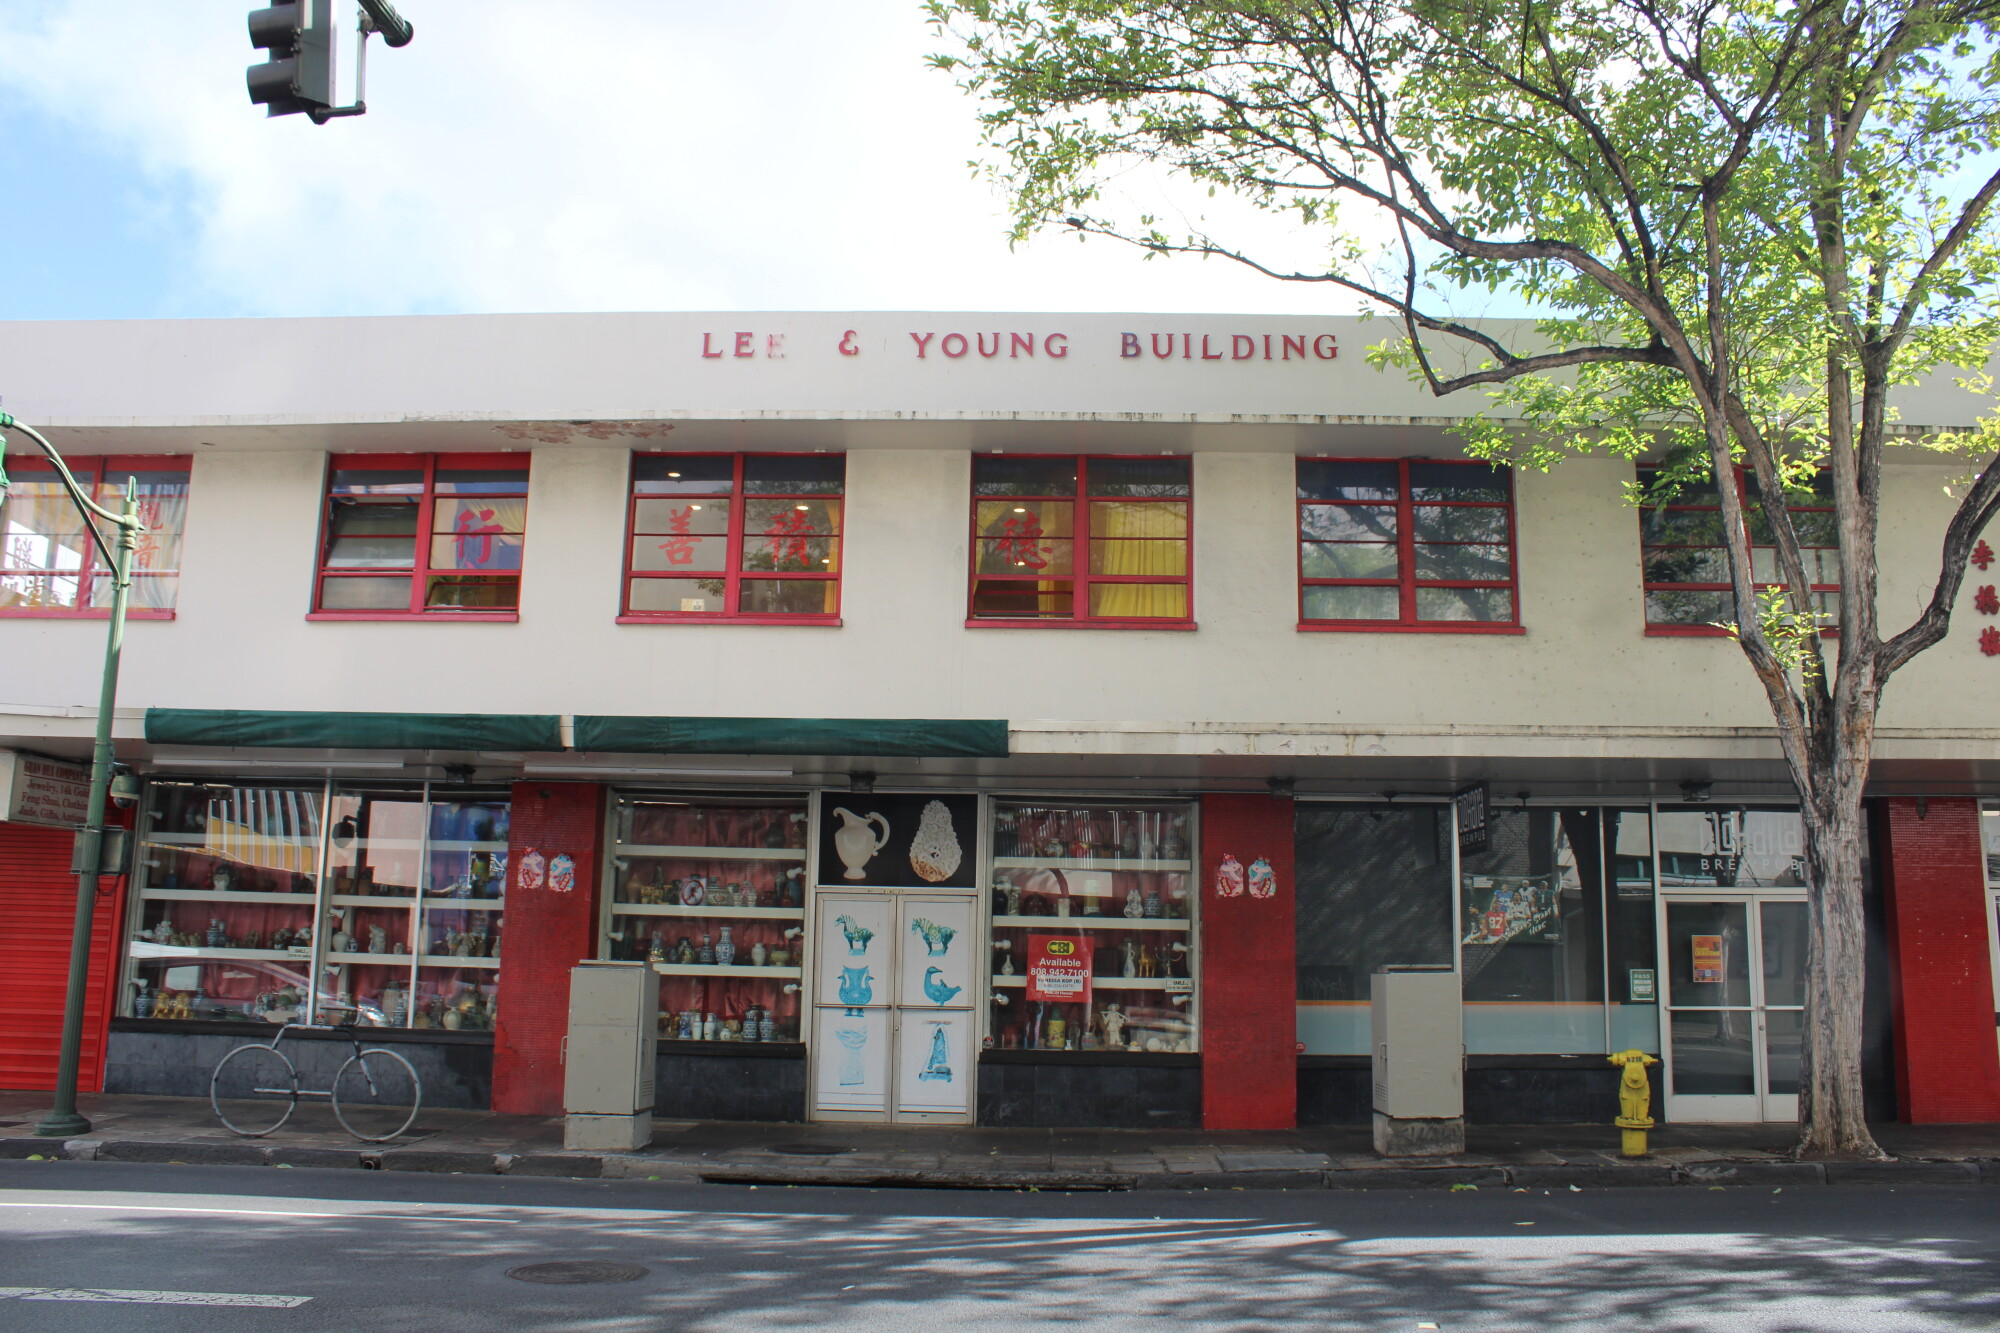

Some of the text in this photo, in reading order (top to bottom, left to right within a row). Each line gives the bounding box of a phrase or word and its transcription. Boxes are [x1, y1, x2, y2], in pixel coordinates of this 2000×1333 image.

[701, 329, 1339, 361] LEE & YOUNG BUILDING
[451, 508, 505, 565] 行
[657, 504, 704, 566] 善
[27, 778, 58, 794] Jewelry,
[21, 791, 88, 811] Feng Shui, Clothin
[18, 805, 87, 823] Jade, Gifts, Antiqu
[1488, 917, 1503, 929] 87
[1048, 941, 1070, 954] CBI
[1040, 957, 1082, 967] Available
[1030, 967, 1089, 977] 808.942.7100
